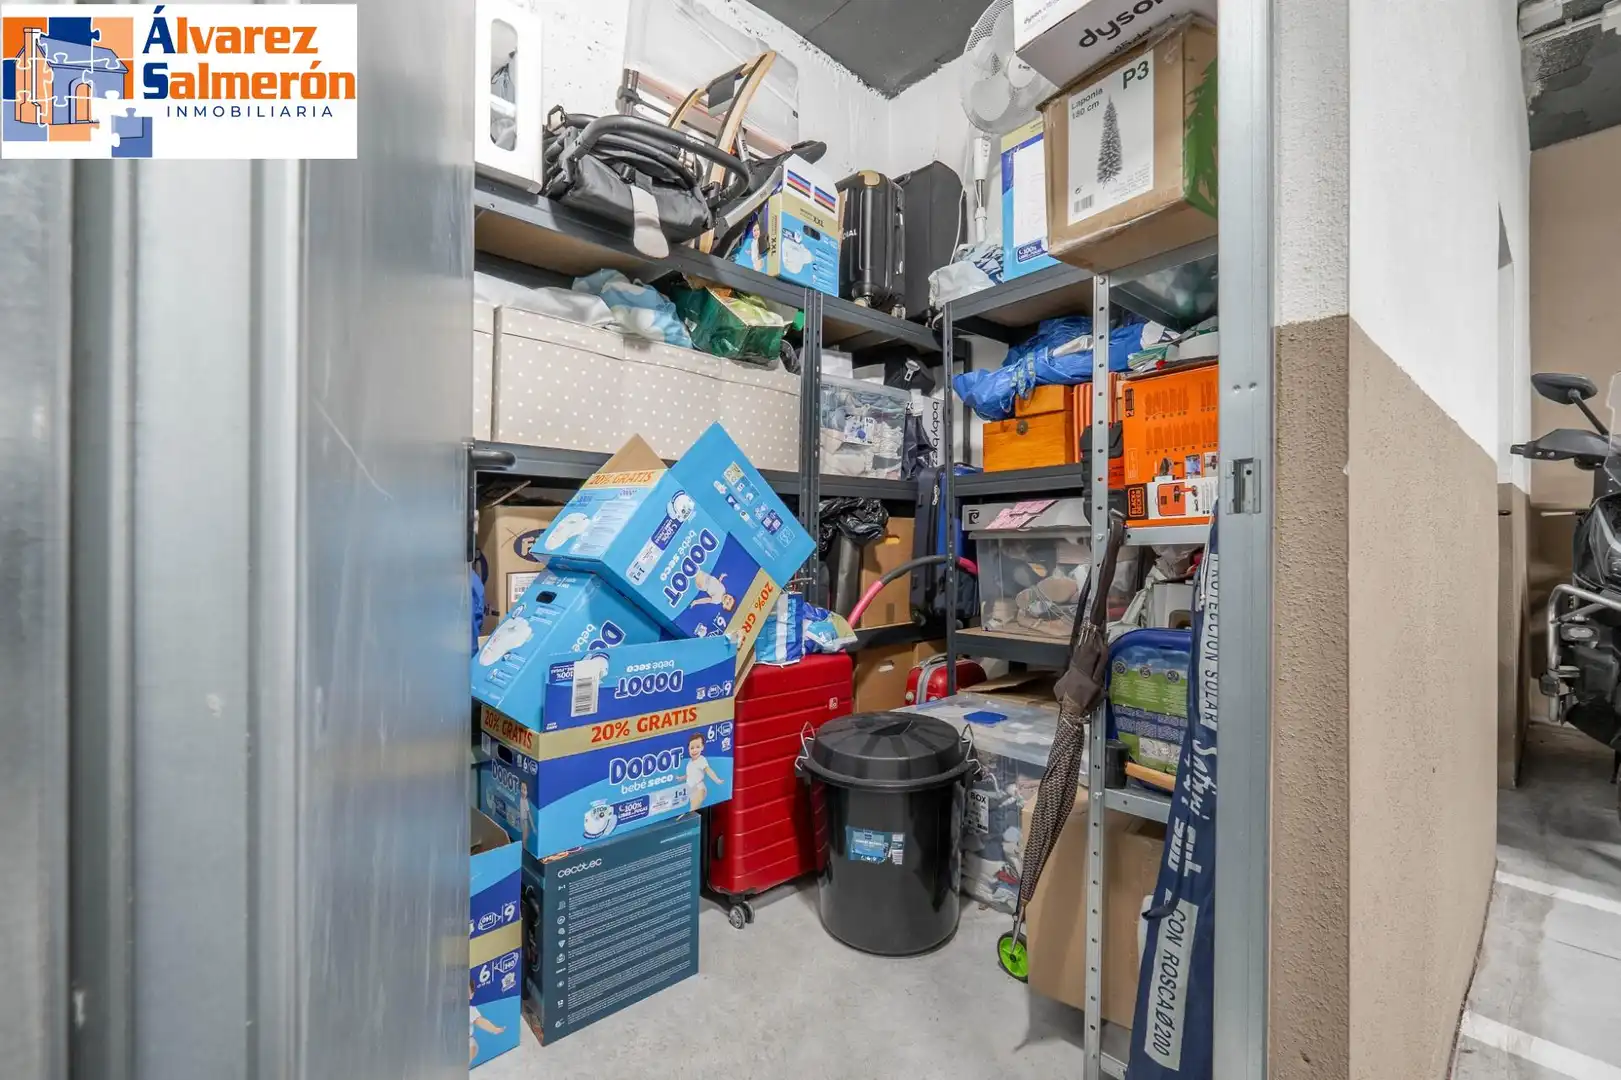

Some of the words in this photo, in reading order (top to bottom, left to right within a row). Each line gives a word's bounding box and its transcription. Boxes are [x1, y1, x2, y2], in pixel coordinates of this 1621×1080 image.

[1078, 0, 1163, 48] dyso
[1122, 60, 1149, 90] P3
[1071, 87, 1103, 110] Laponia
[662, 527, 720, 608] DODOT
[614, 669, 684, 699] DODOT
[1205, 669, 1219, 723] SOLAR
[484, 710, 500, 732] 20%
[502, 720, 534, 750] GRATIS
[591, 719, 630, 744] 20%
[636, 706, 698, 733] GRATIS
[707, 725, 715, 740] 6
[609, 746, 685, 786] DODOT
[647, 772, 674, 787] seco
[970, 792, 987, 804] BOX
[557, 858, 602, 878] cecotec
[1166, 909, 1186, 947] CON
[1156, 949, 1180, 1011] ROSCA
